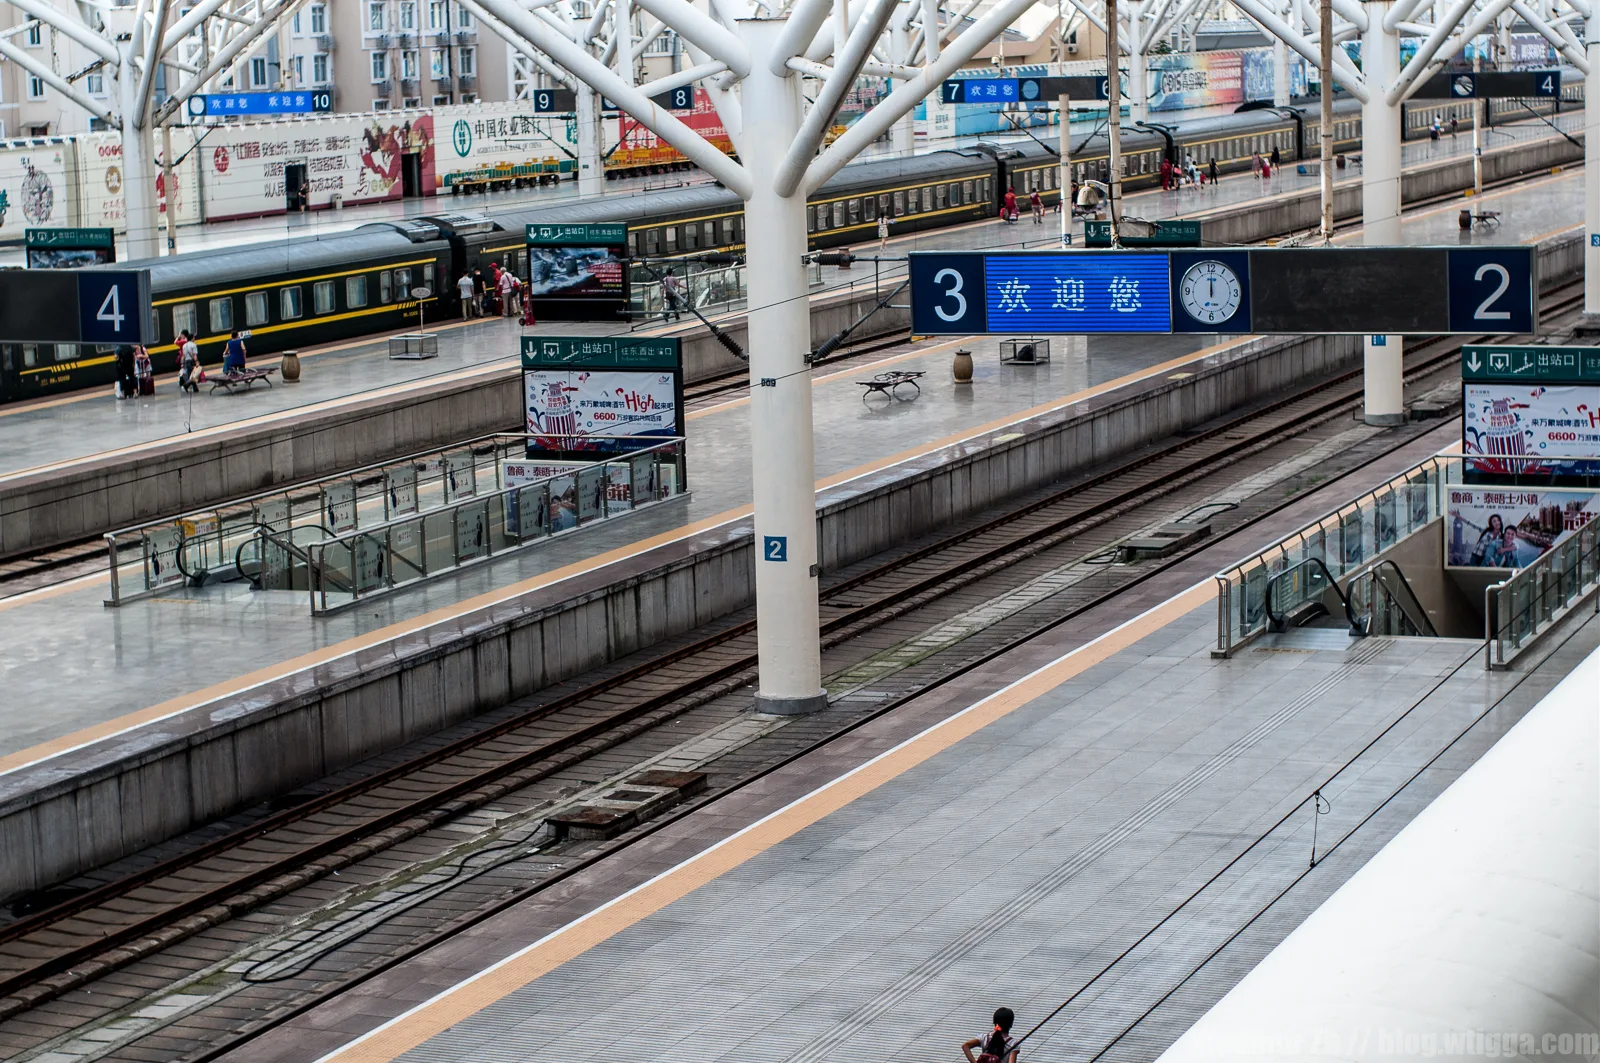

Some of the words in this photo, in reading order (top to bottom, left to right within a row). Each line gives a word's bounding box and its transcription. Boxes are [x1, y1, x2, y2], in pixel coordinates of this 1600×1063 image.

[948, 83, 960, 100] 7
[970, 84, 1014, 97] 欢迎您
[1542, 75, 1554, 94] 4
[212, 97, 248, 109] 欢迎您
[268, 95, 306, 107] 欢迎您
[313, 94, 330, 109] 10
[538, 93, 550, 109] 9
[675, 90, 687, 107] 8
[474, 114, 542, 140] 中国农业银行
[564, 227, 585, 235] 出站口
[1207, 264, 1216, 273] 12
[933, 268, 967, 322] 3
[997, 276, 1142, 312] 欢迎您
[1185, 287, 1191, 296] 9
[1233, 289, 1239, 298] 3
[1473, 263, 1511, 320] 2
[96, 284, 125, 332] 4
[1208, 312, 1215, 321] 6
[582, 343, 612, 354] 出站口
[1538, 353, 1575, 366] 出站口
[624, 390, 655, 412] High
[593, 412, 616, 421] 6600
[1547, 432, 1576, 441] 6600
[769, 540, 782, 559] 2
